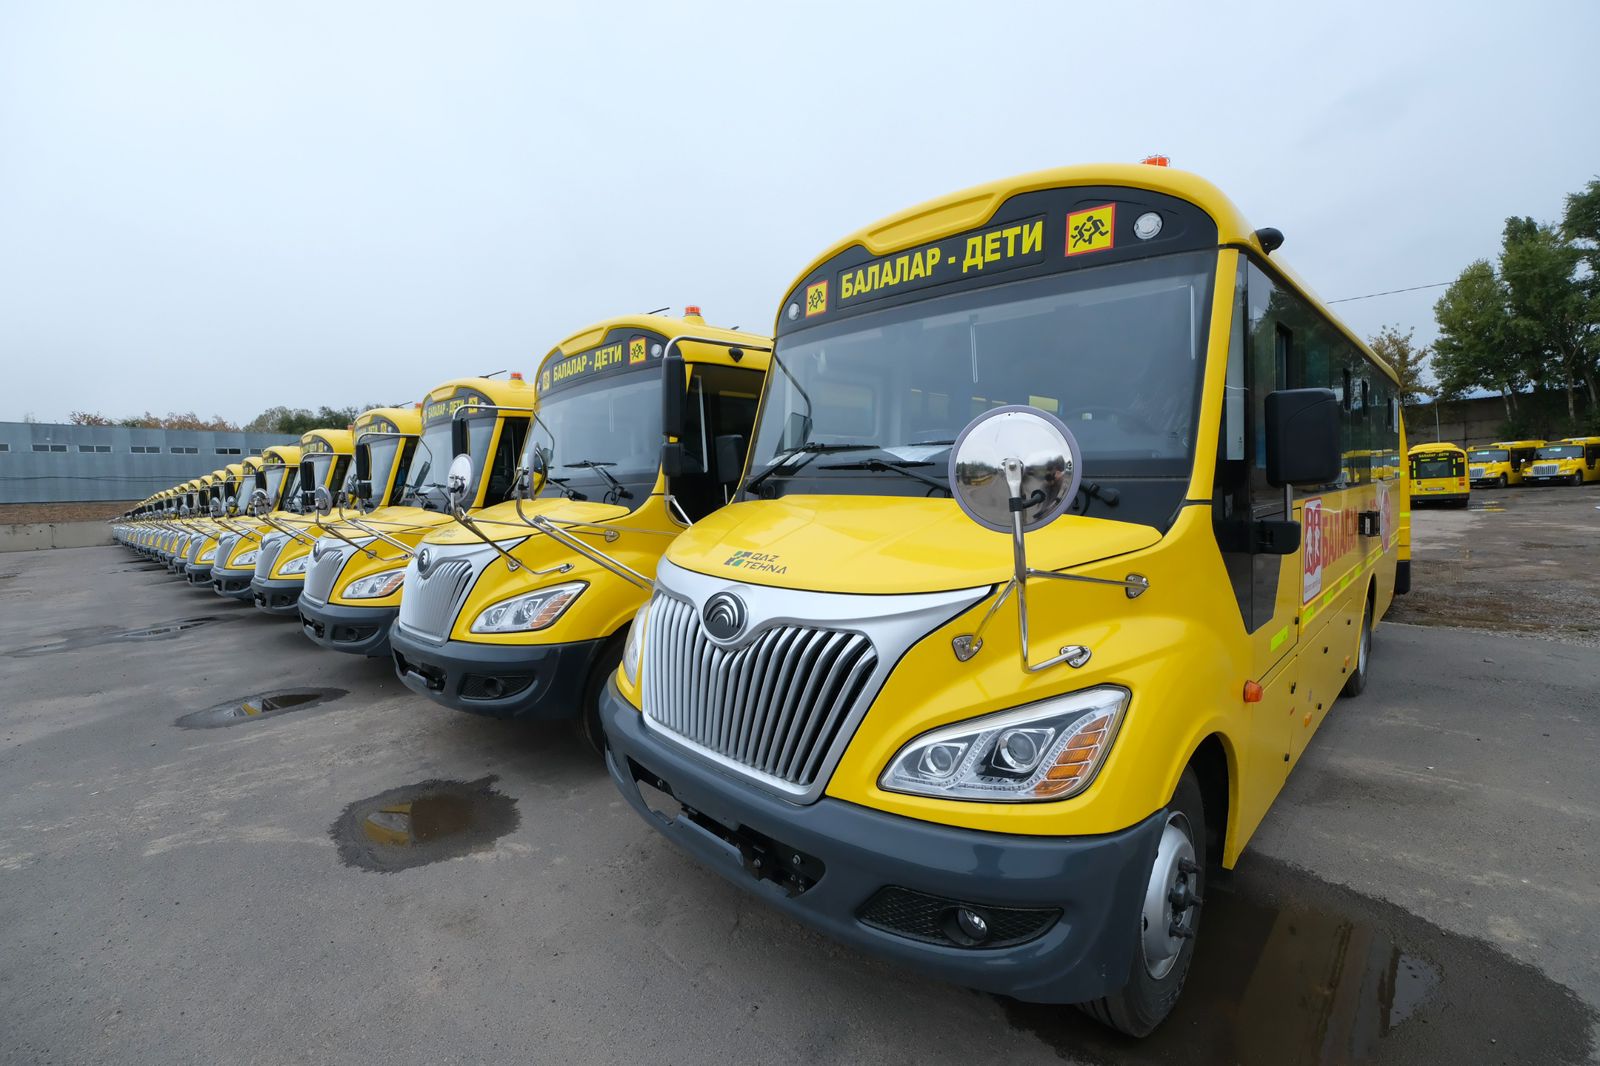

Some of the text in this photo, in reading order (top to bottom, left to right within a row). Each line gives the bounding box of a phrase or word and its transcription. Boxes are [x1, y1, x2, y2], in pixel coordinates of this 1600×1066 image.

[841, 247, 941, 299] БАЛАЛАР
[962, 220, 1043, 273] ДЕТИ
[553, 355, 587, 382] БАЛАЛАР
[594, 345, 622, 371] ДЕТИ
[743, 561, 788, 574] TEHNA
[751, 553, 780, 562] QAZ
